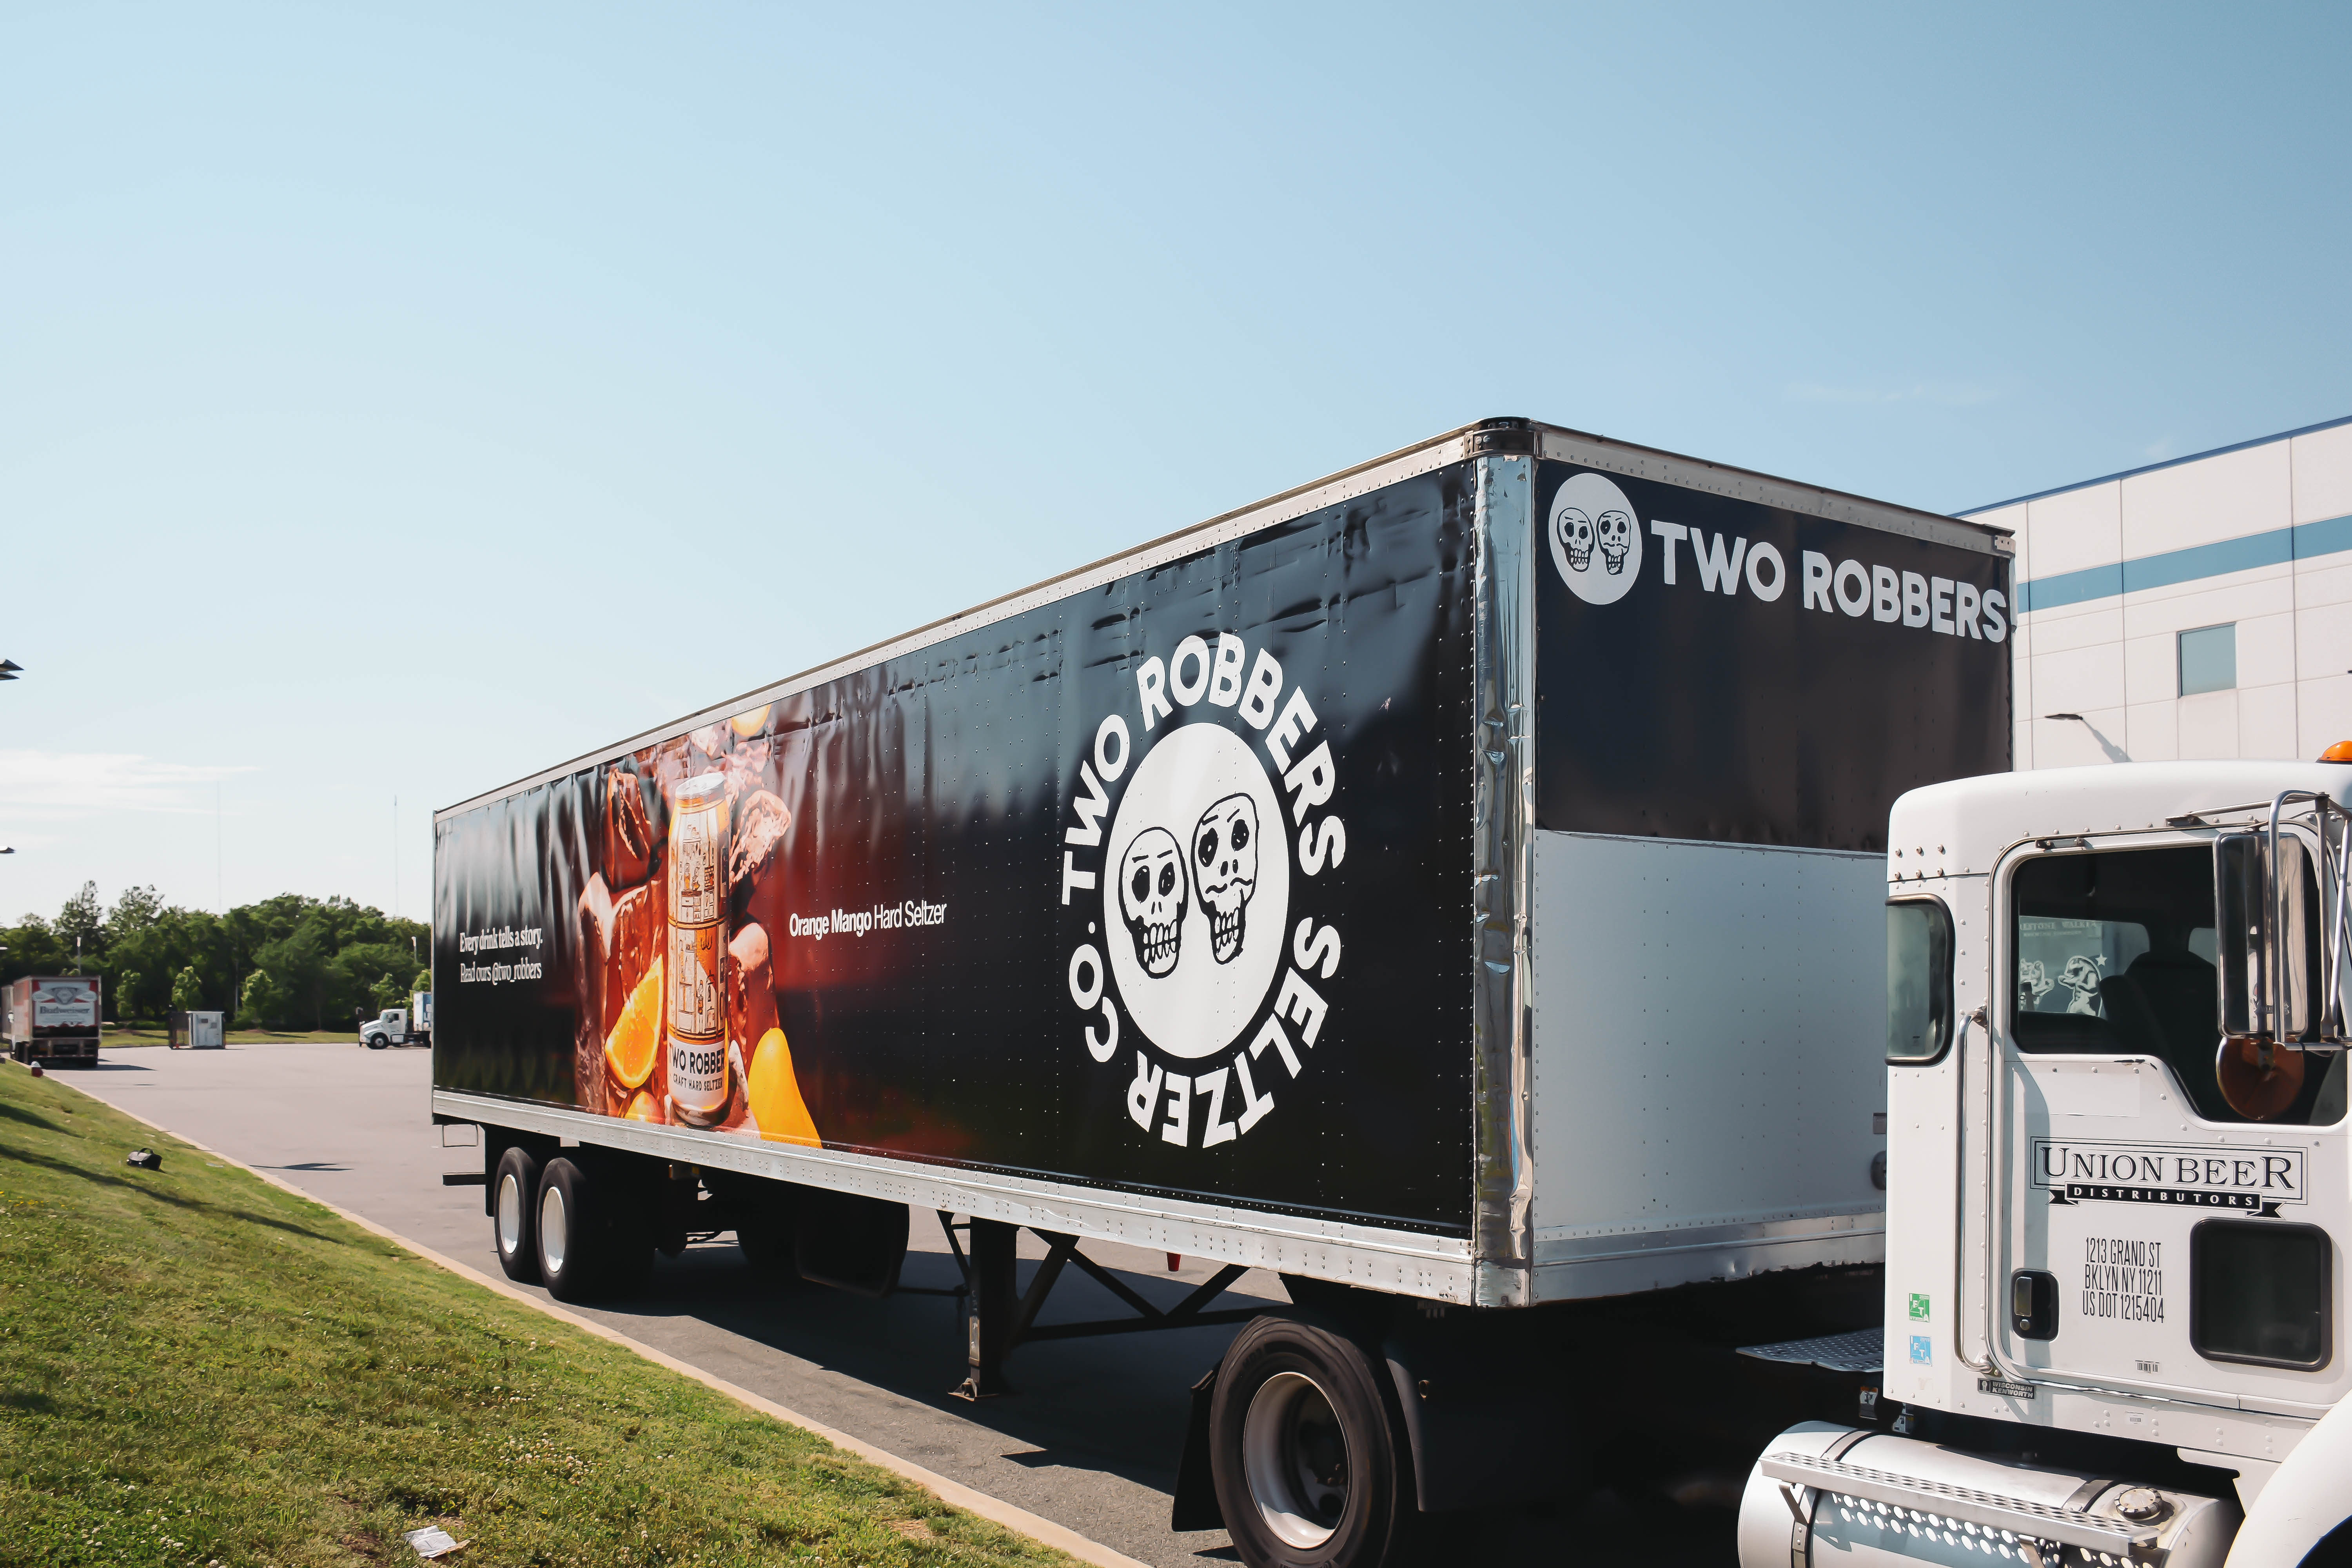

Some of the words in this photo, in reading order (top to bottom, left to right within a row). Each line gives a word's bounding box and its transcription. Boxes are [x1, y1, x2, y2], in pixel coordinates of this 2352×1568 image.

[1651, 520, 1785, 601] TWO
[1803, 550, 2006, 643] ROBBERS
[1136, 632, 1346, 876] ROBBERS
[1062, 714, 1130, 905] TWO
[789, 913, 829, 940] Orange
[831, 908, 872, 937] Mango
[875, 902, 902, 929] Hard
[905, 899, 947, 927] Seltzer
[460, 932, 479, 955] Every
[479, 927, 498, 950] drink
[499, 926, 514, 948] tells
[515, 931, 520, 946] a
[521, 925, 543, 949] story.
[461, 961, 475, 982] Read
[476, 967, 491, 982] ours
[492, 957, 542, 985] @two_robbers
[1069, 922, 1119, 1062] CO.
[1128, 917, 1341, 1148] SELTZER
[688, 1079, 702, 1091] HARD
[2040, 1147, 2163, 1184] UNION
[2174, 1155, 2295, 1191] BEER
[2074, 1187, 2252, 1206] DISTRIBUTORS
[2086, 1237, 2107, 1263] 1213
[2111, 1239, 2145, 1267] GRAND
[2149, 1242, 2161, 1268] ST
[2085, 1264, 2118, 1292] BKLYN
[2122, 1267, 2135, 1293] NY
[2139, 1268, 2161, 1296] 11211
[2083, 1290, 2095, 1316] US
[2099, 1292, 2117, 1318] DOT
[2120, 1294, 2164, 1323] 1215404
[1992, 1387, 2033, 1398] KENWORTH
[1993, 1381, 2033, 1392] WISCONSIN
